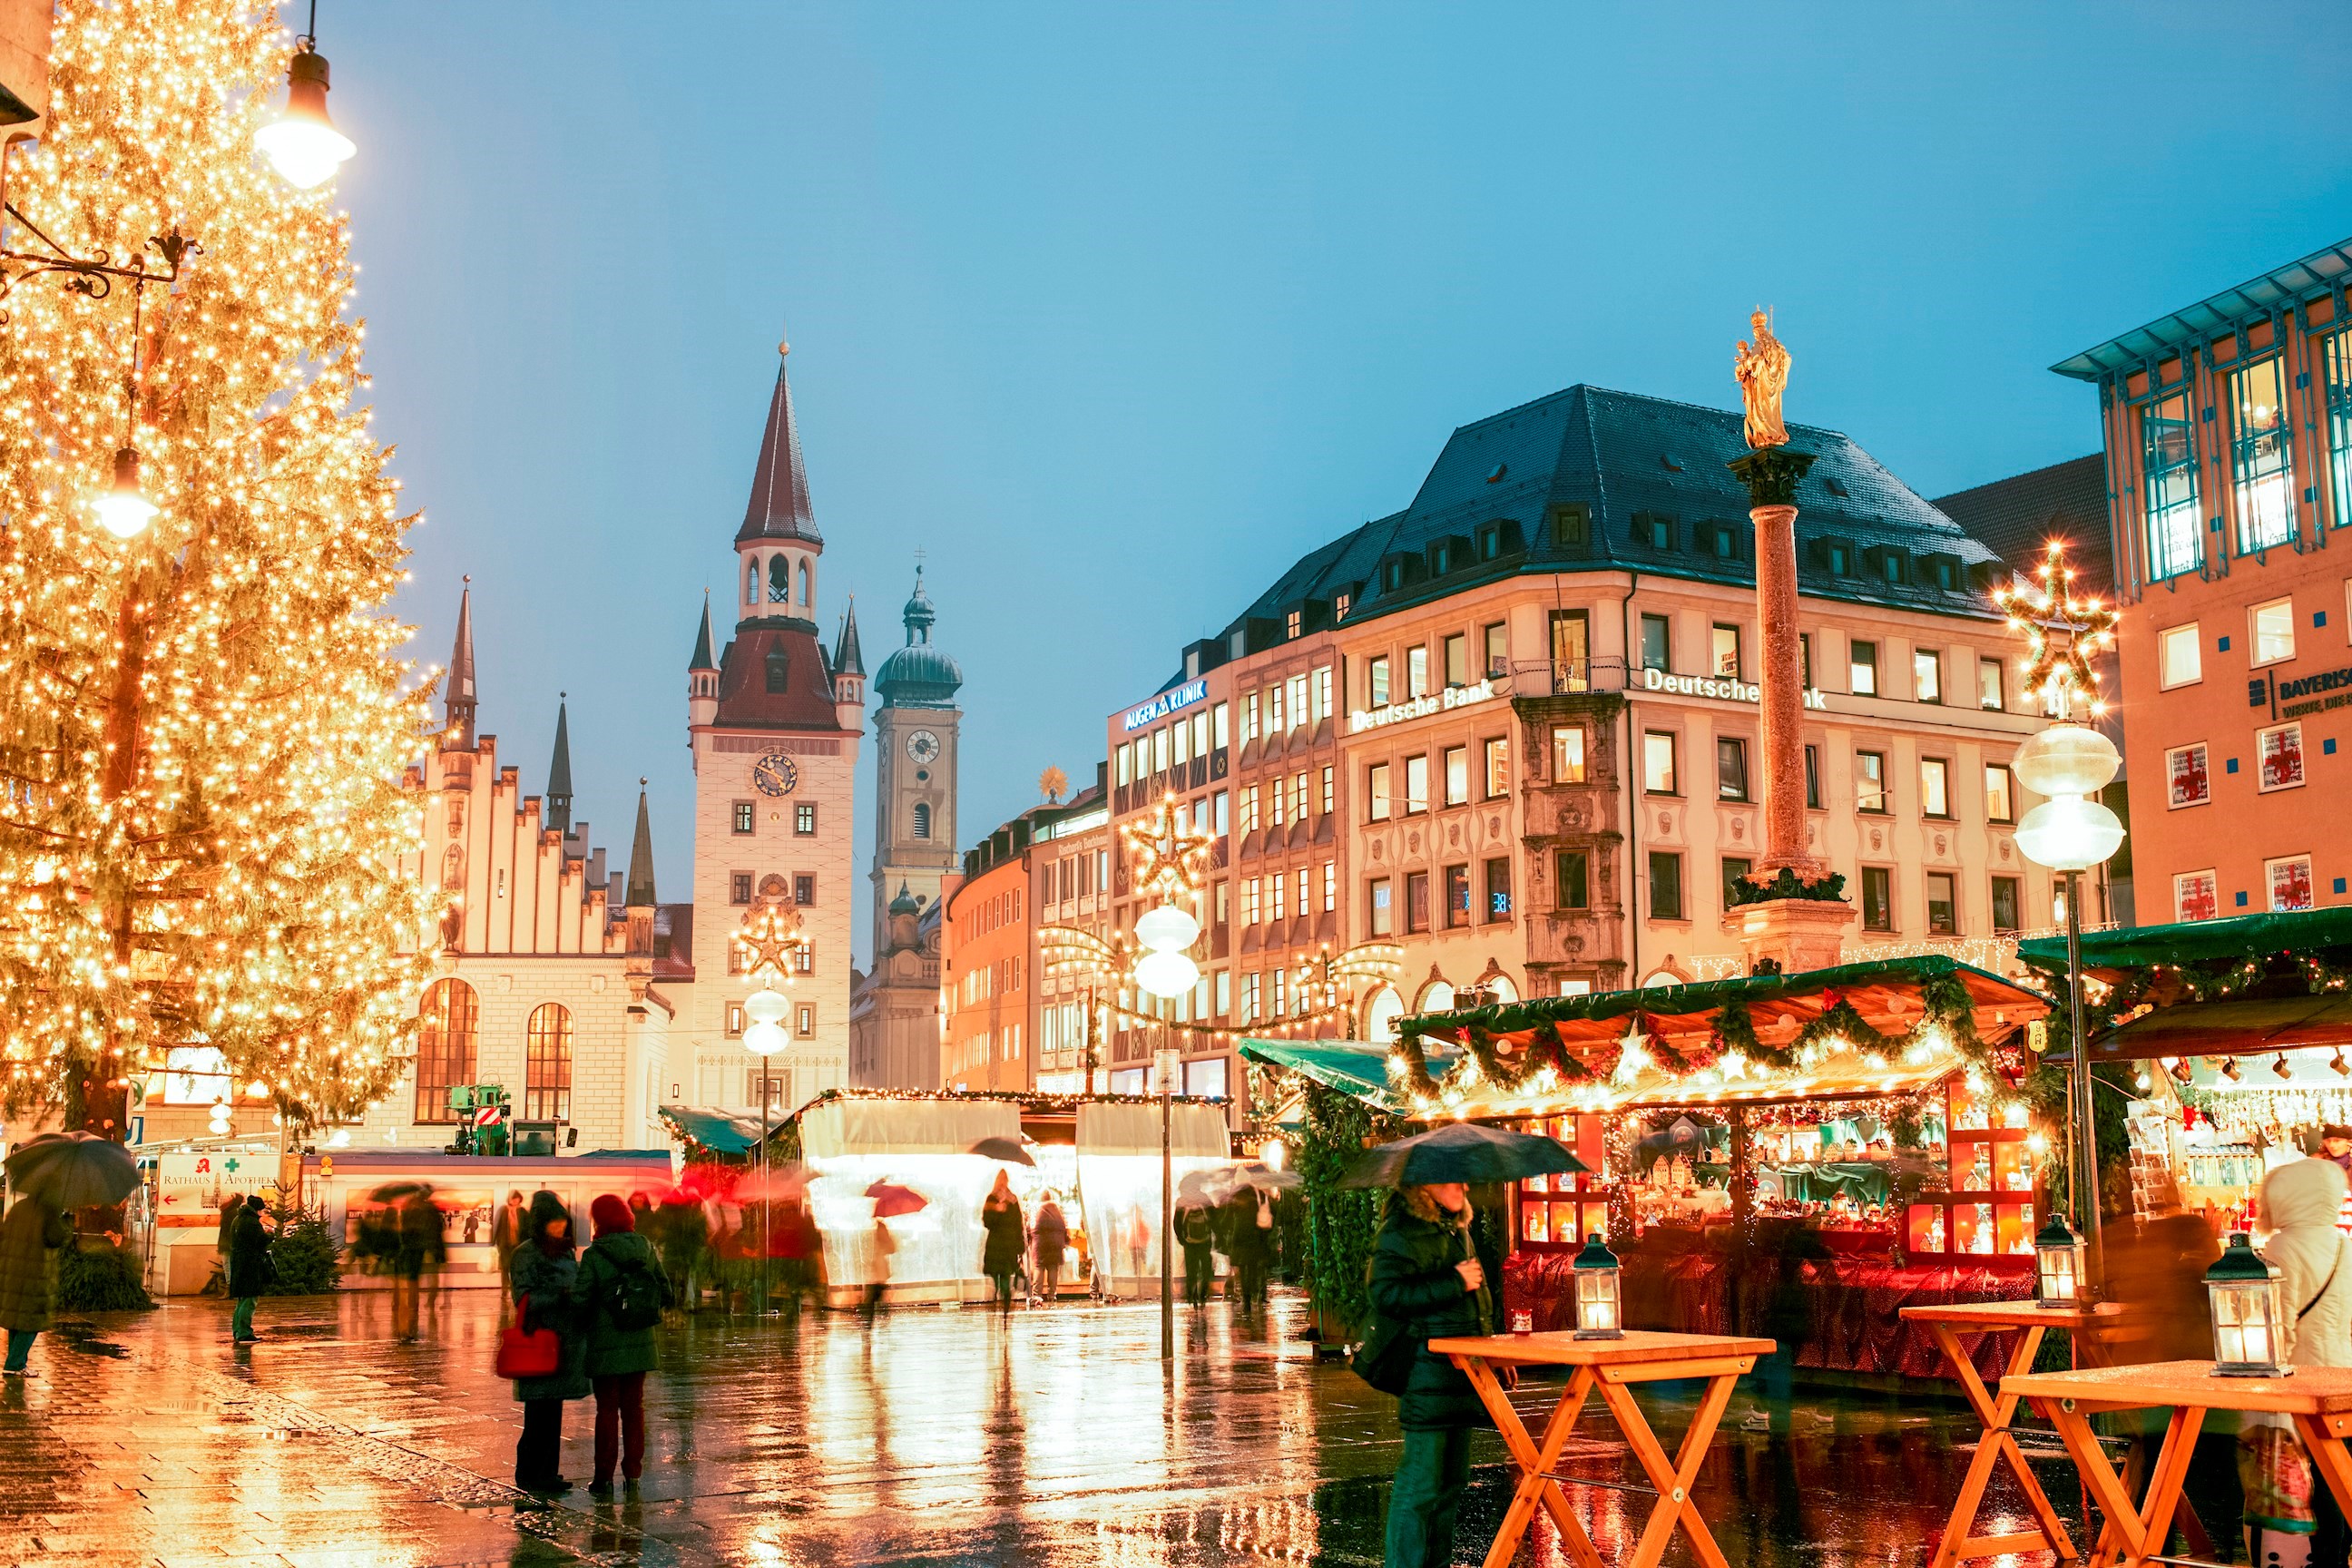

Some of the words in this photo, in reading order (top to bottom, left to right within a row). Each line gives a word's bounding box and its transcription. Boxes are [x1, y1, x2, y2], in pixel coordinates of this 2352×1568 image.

[1125, 702, 1157, 730] AUGEN
[1171, 681, 1205, 710] KLINIK
[1352, 696, 1439, 732] Deutsche
[1444, 679, 1494, 710] Bank
[1644, 668, 1759, 702] Deutsche
[1802, 687, 1827, 710] nk
[1083, 834, 1108, 849] Backhau
[164, 1175, 211, 1185] RATHAUS
[224, 1173, 279, 1185] APOTHEKE
